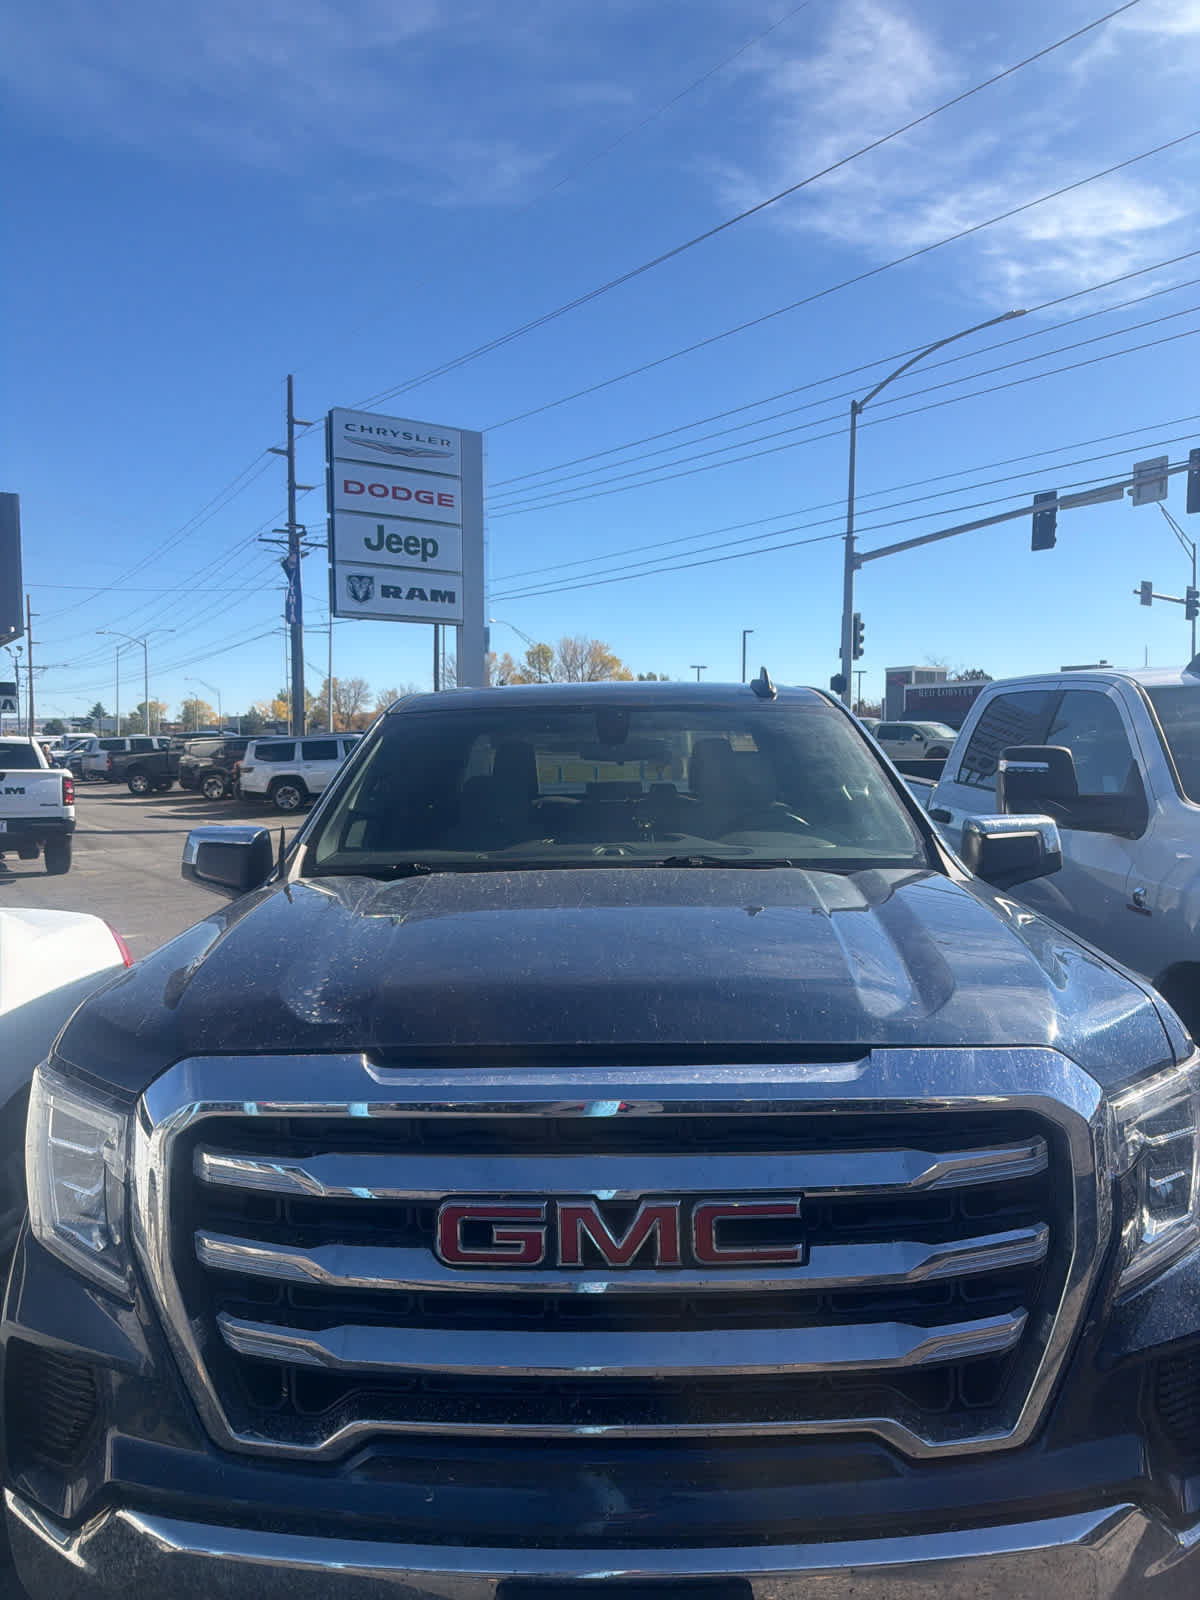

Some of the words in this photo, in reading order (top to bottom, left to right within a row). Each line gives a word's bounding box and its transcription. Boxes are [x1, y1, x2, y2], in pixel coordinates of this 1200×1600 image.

[344, 423, 452, 447] CHRYSLER
[343, 479, 455, 508] DODGE
[364, 524, 439, 562] Jeep
[381, 584, 456, 604] RAM
[437, 1197, 803, 1267] GMC
